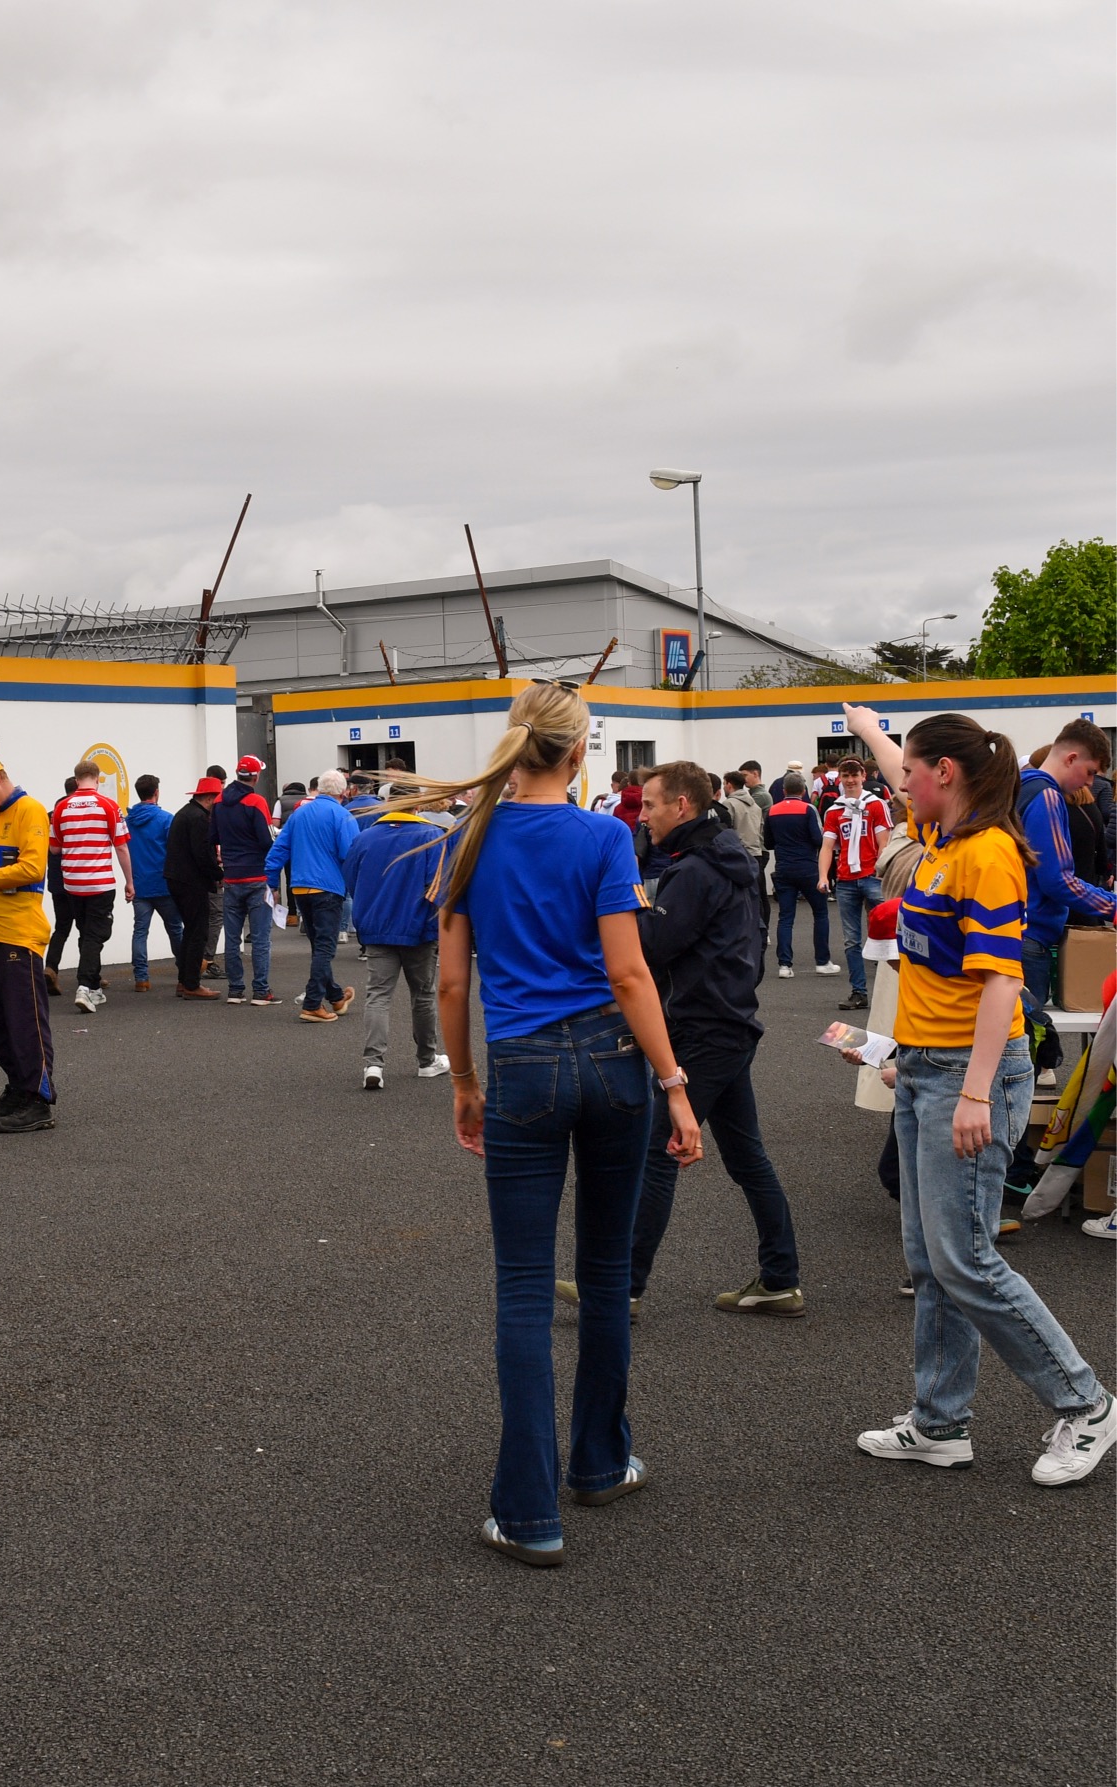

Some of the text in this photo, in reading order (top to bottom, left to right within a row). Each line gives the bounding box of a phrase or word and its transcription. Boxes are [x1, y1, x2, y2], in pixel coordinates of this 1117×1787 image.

[667, 673, 688, 686] ALD
[832, 723, 843, 732] 10
[350, 730, 361, 739] 12
[389, 728, 400, 737] 11
[895, 1430, 916, 1448] N
